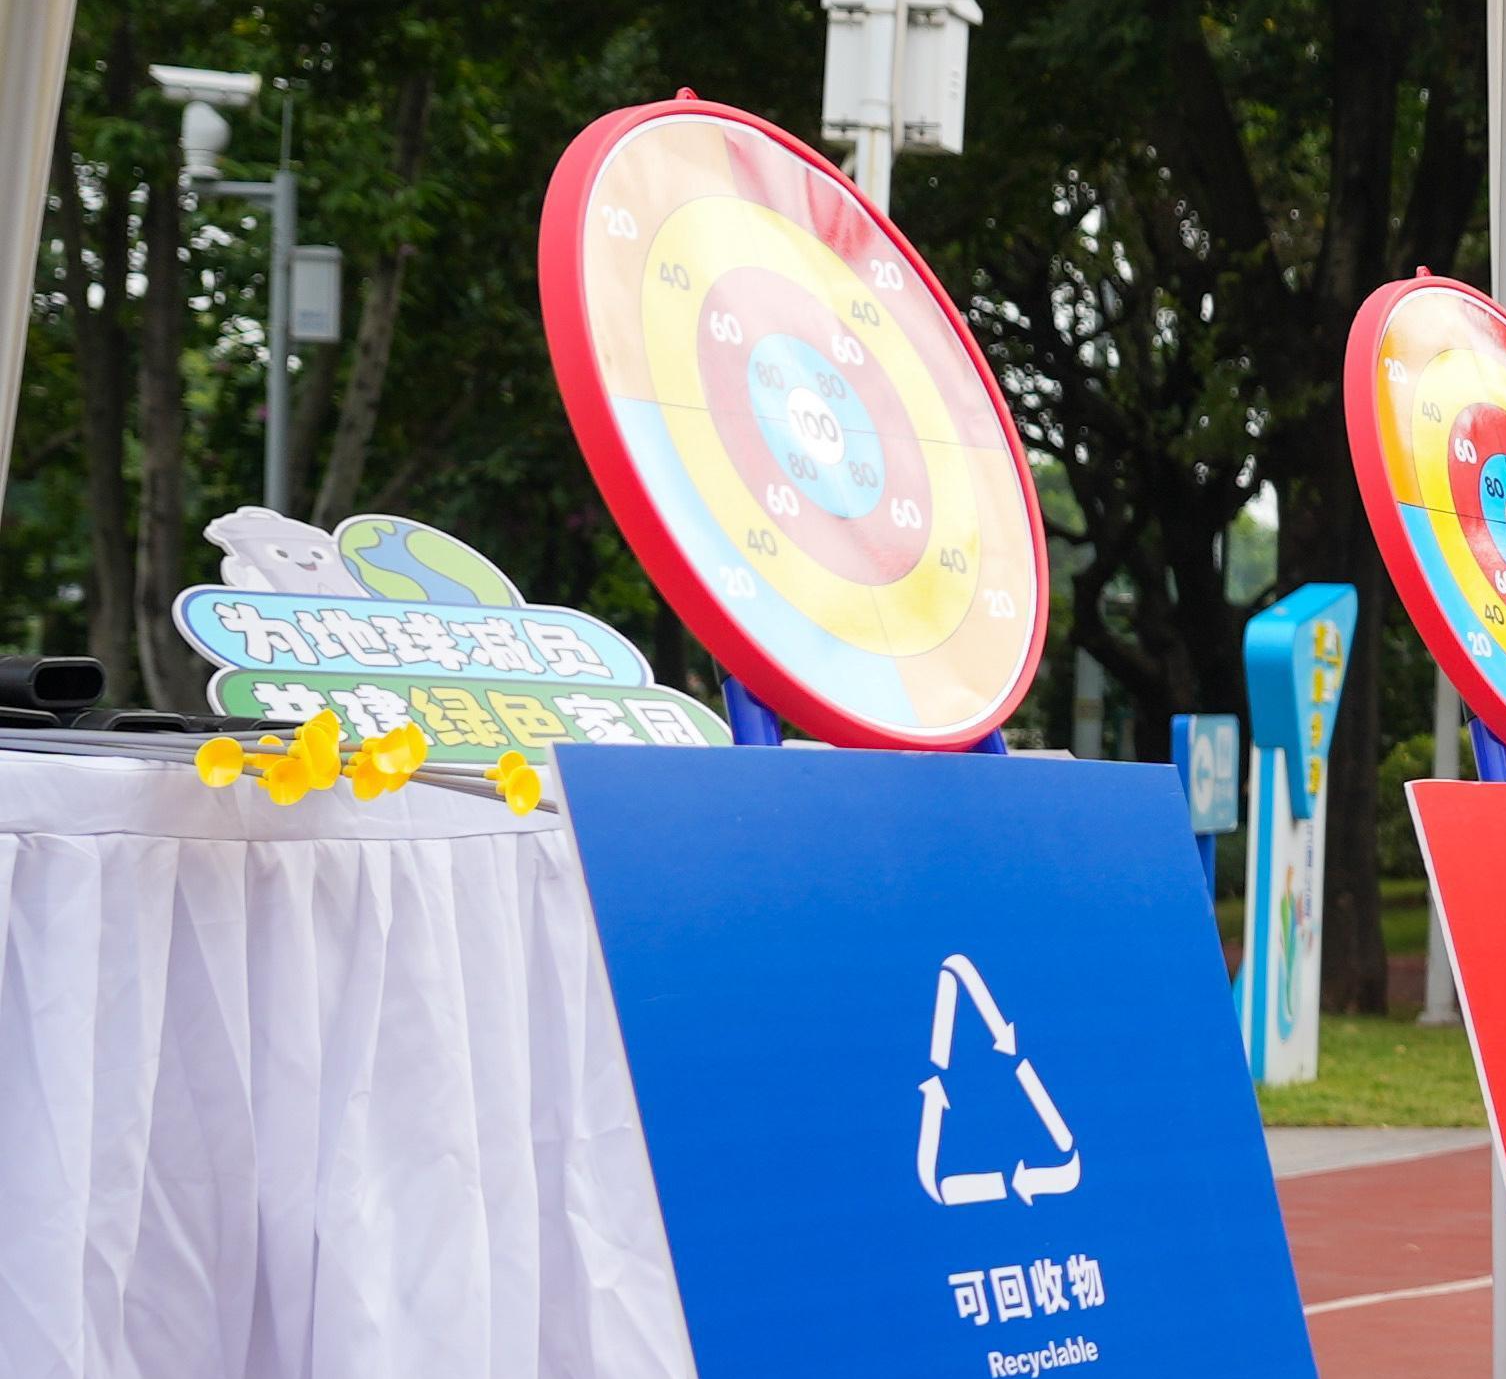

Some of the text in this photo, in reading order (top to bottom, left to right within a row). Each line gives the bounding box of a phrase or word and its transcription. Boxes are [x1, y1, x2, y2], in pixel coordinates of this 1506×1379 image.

[602, 206, 637, 240] 20
[660, 264, 690, 292] 40
[871, 260, 903, 292] 20
[711, 311, 743, 344] 60
[851, 302, 879, 327] 40
[831, 334, 864, 366] 60
[756, 363, 784, 389] 80
[1384, 358, 1407, 384] 20
[818, 373, 847, 400] 80
[1422, 402, 1442, 423] 40
[793, 410, 837, 444] 100
[1455, 438, 1477, 464] 60
[789, 455, 817, 481] 80
[850, 461, 877, 486] 80
[766, 485, 799, 516] 60
[1485, 477, 1504, 498] 80
[891, 498, 922, 530] 60
[748, 529, 778, 556] 40
[941, 548, 967, 573] 40
[720, 567, 755, 598] 20
[984, 590, 1014, 619] 20
[1484, 604, 1504, 625] 40
[213, 602, 612, 679] 为地球减负
[1469, 633, 1493, 658] 20
[252, 682, 708, 748] 共建绿色家园
[947, 1253, 1106, 1326] 可回收物
[987, 1335, 1100, 1379] Recyclable
